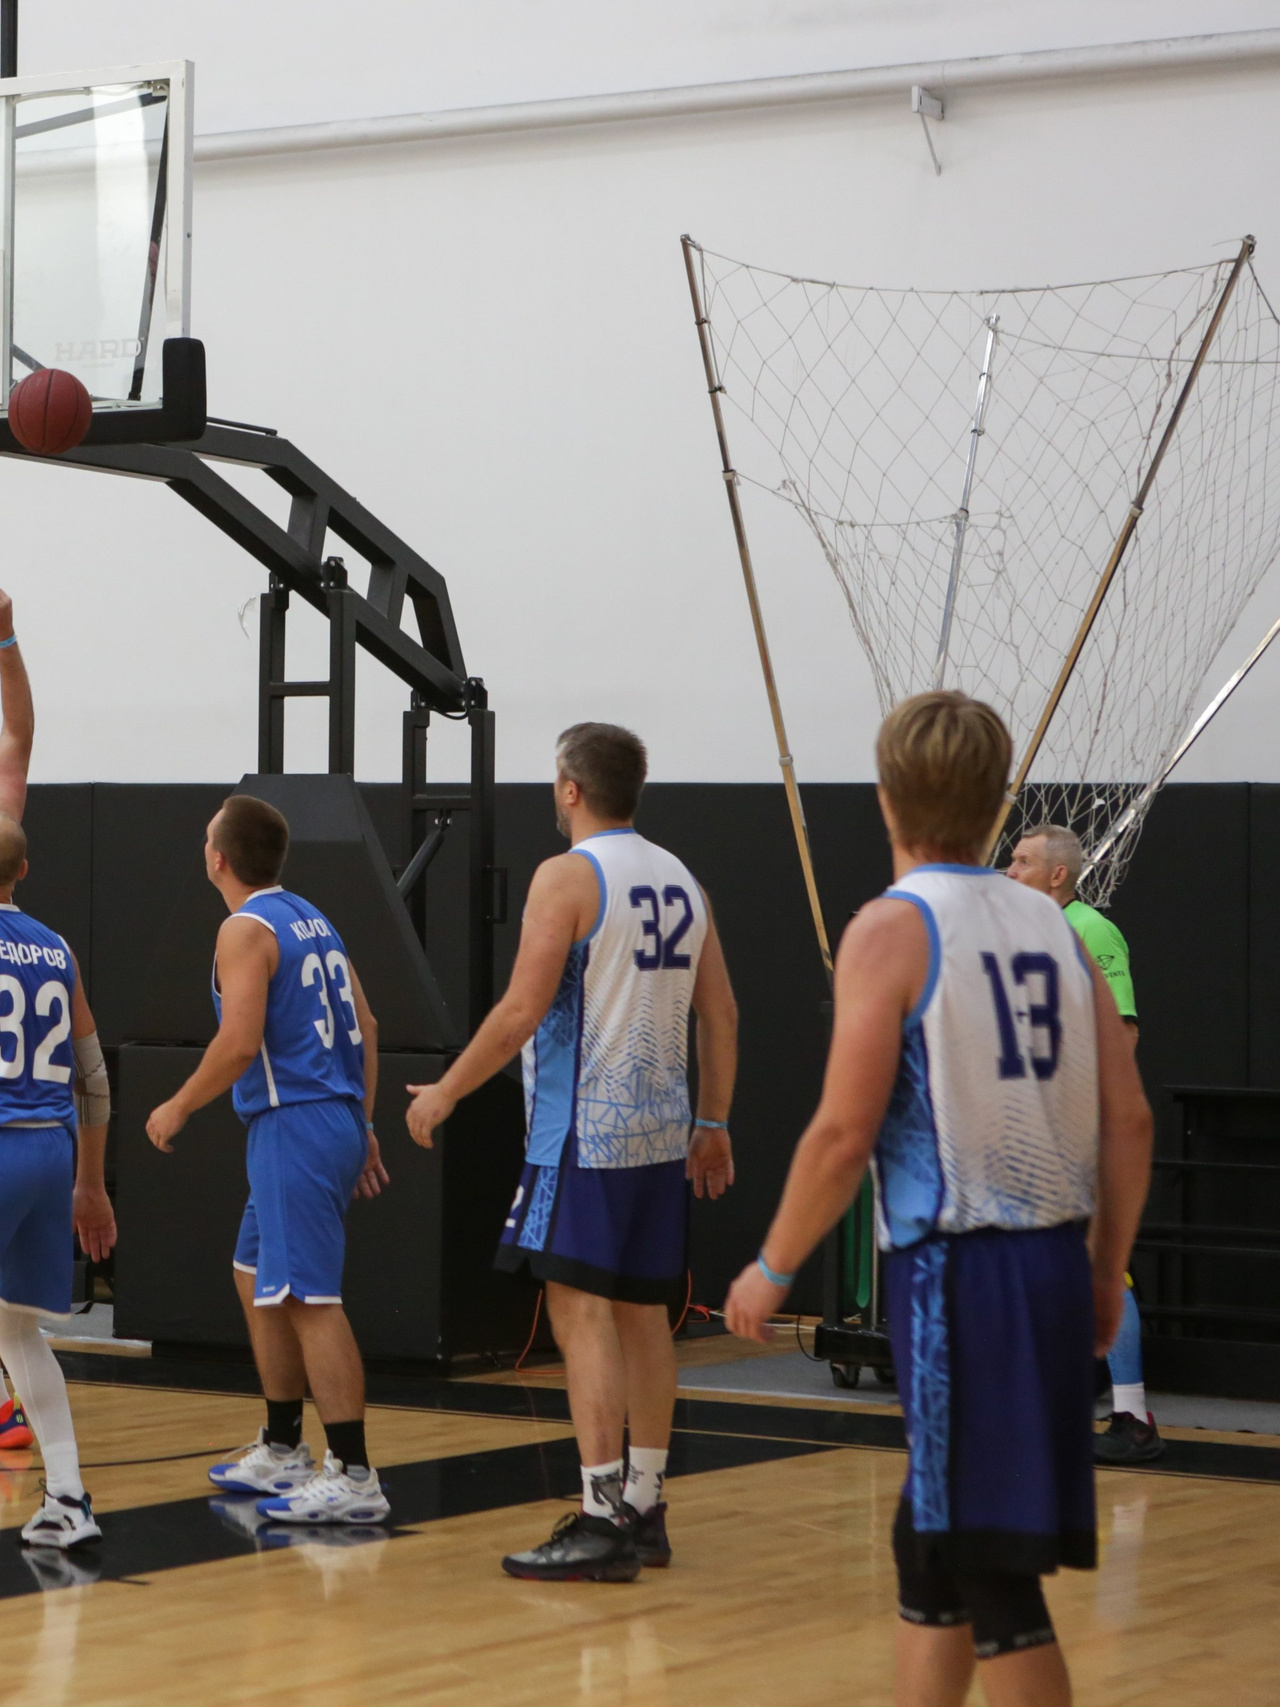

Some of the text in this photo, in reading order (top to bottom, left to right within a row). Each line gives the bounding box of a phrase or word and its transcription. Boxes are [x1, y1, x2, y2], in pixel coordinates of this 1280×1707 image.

[54, 338, 142, 361] HARD
[628, 884, 694, 971] 32
[301, 950, 363, 1050] 33
[979, 952, 1063, 1081] 13
